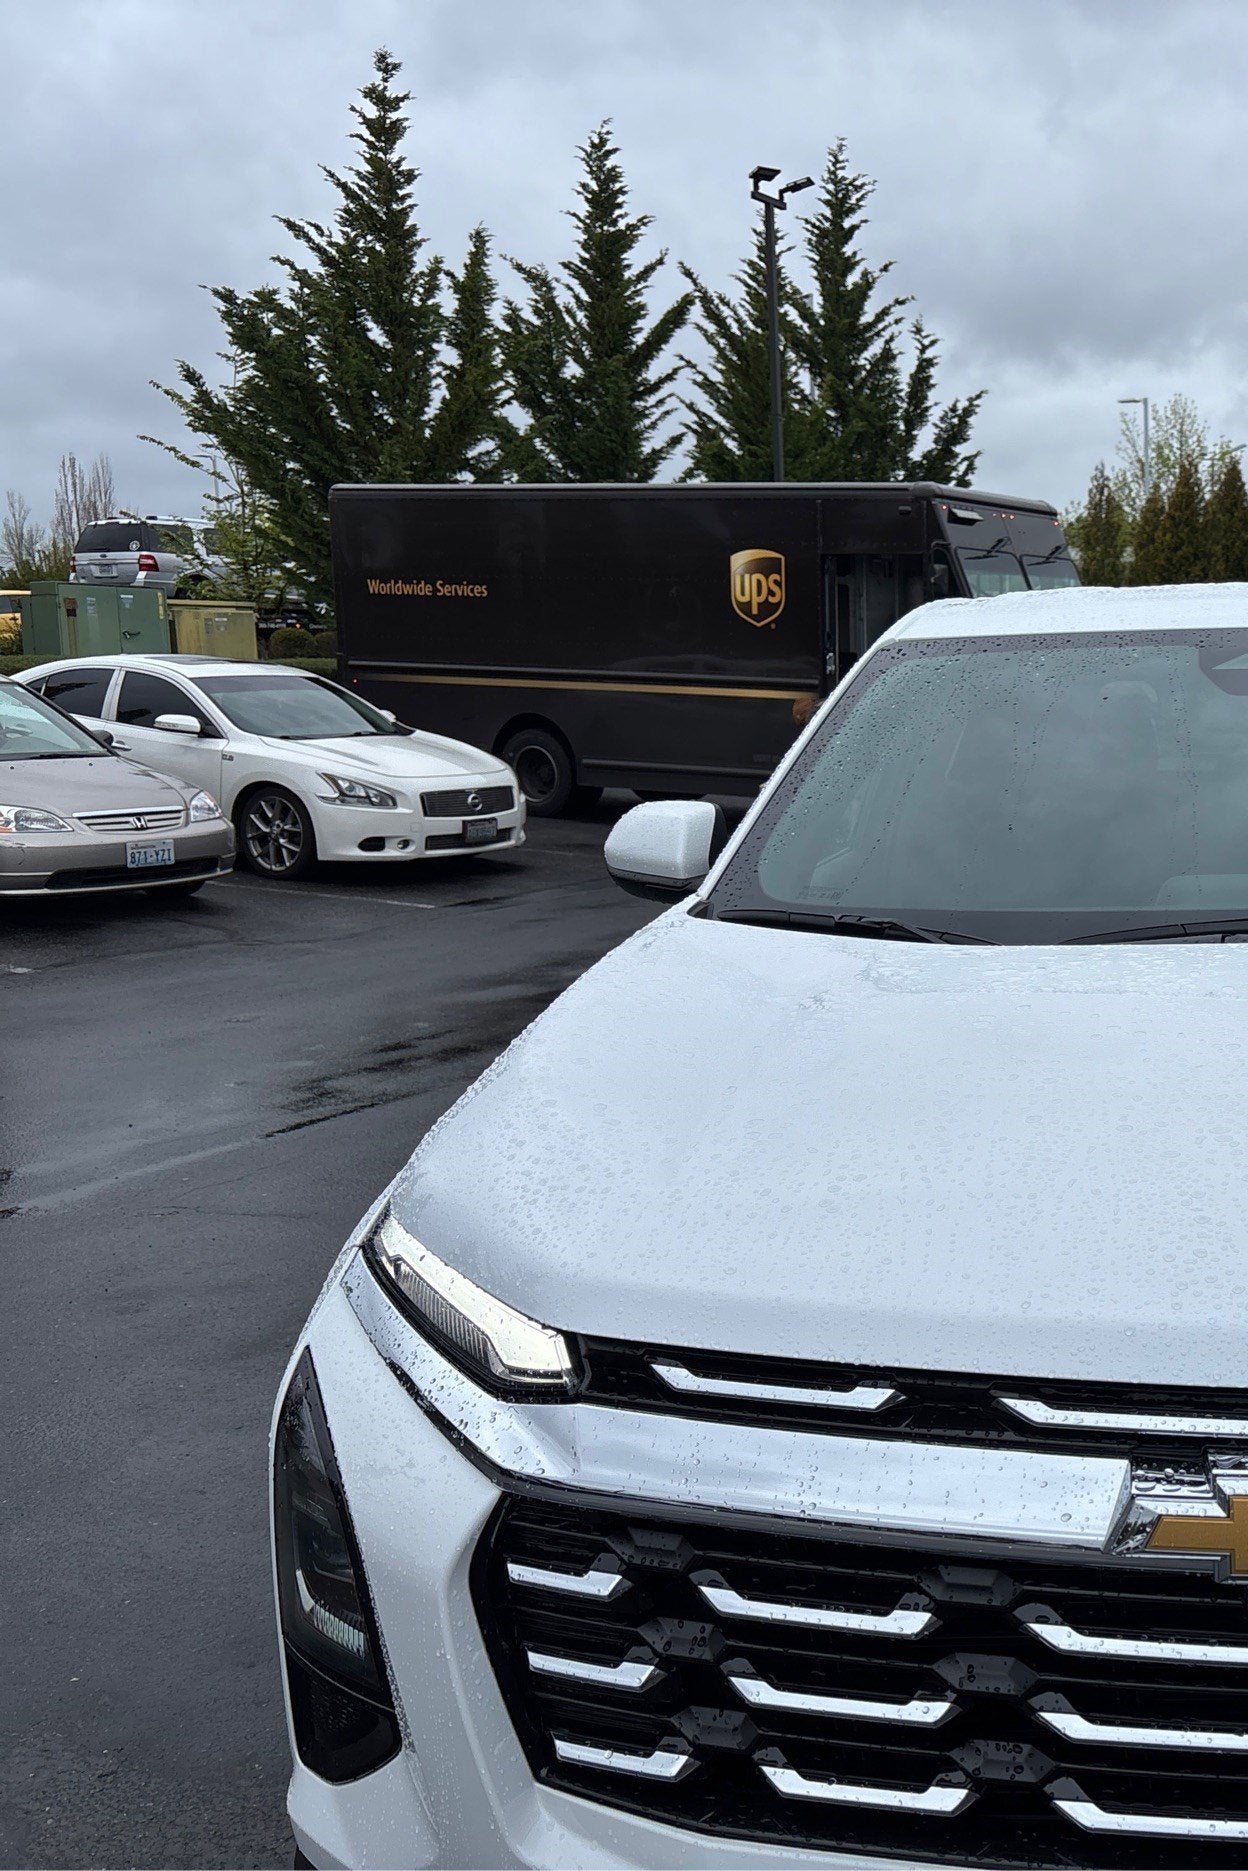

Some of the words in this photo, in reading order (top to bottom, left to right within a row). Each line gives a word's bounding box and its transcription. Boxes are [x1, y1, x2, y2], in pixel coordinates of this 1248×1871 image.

[367, 579, 433, 596] Worldwide
[436, 580, 488, 598] Services
[735, 573, 782, 615] ups
